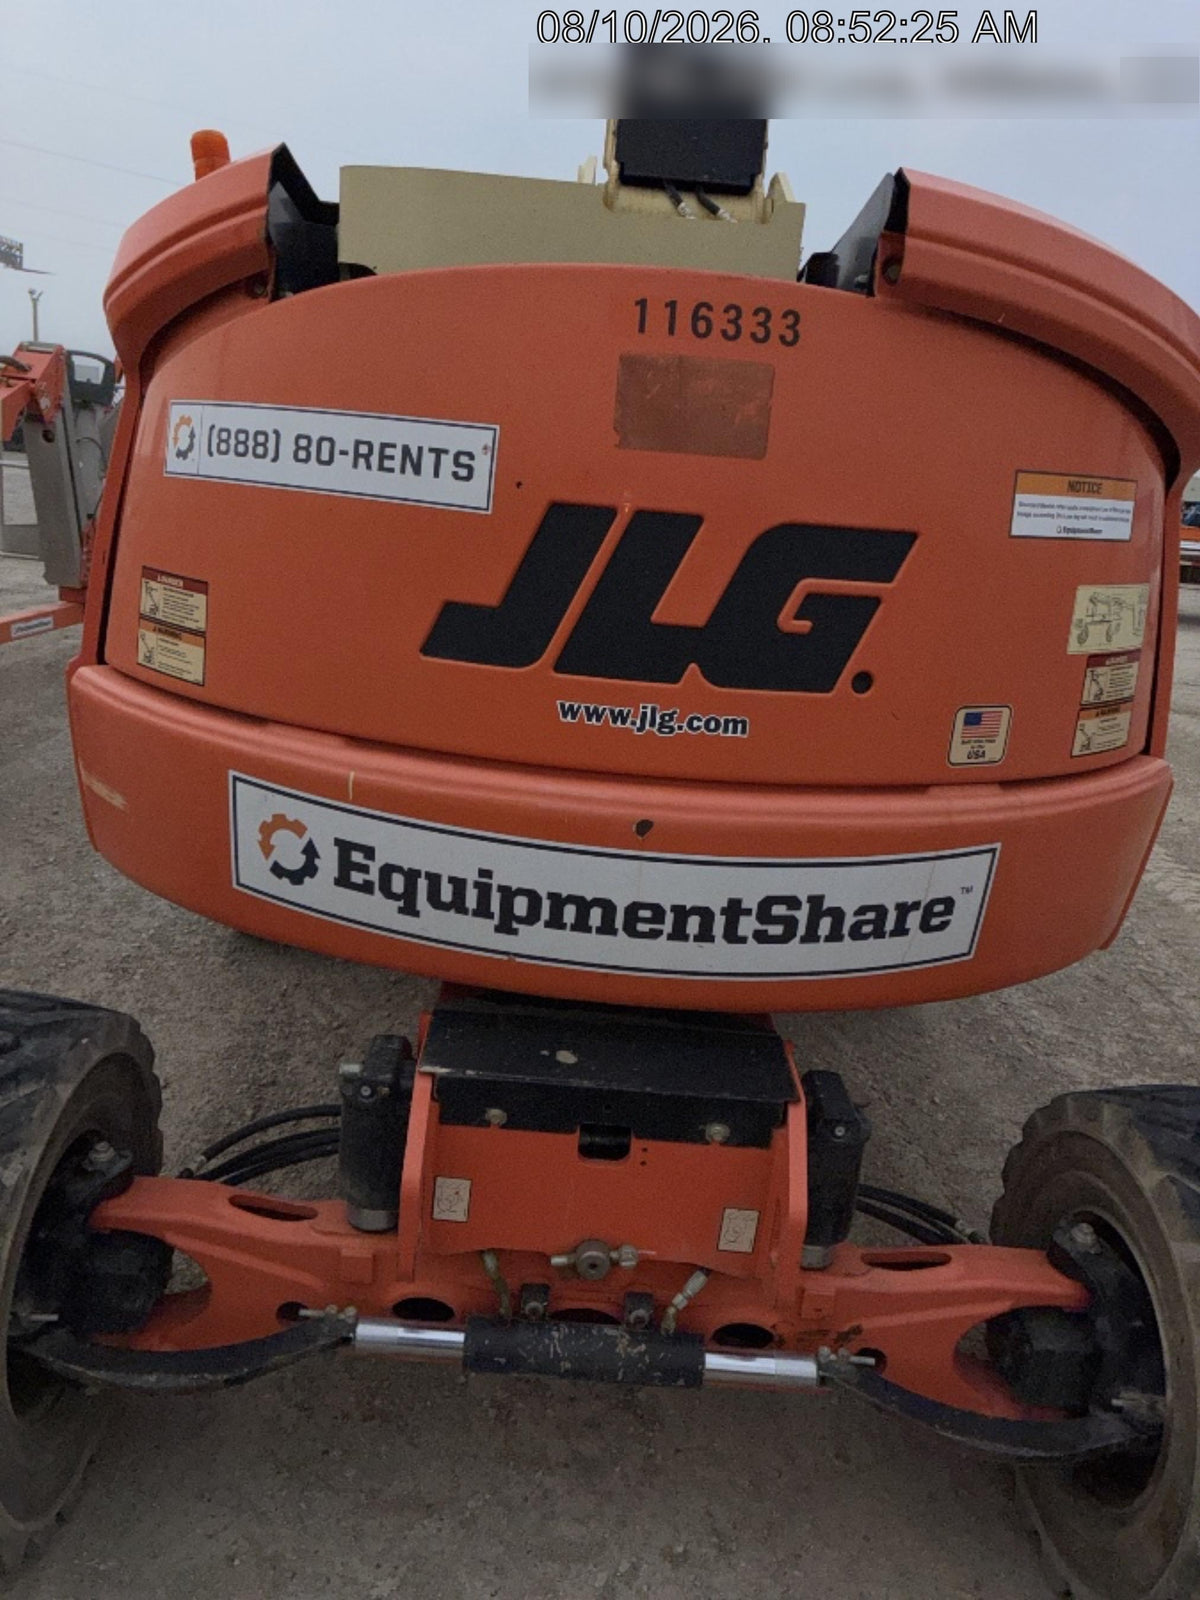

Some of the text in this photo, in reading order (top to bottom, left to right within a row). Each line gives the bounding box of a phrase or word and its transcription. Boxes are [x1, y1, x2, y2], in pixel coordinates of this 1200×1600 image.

[634, 297, 801, 347] 116333
[207, 424, 476, 482] (888) 80-RENTS
[1067, 479, 1103, 495] NOTICE
[557, 700, 748, 736] www.jlg.com
[333, 838, 956, 946] EquipmentShare
